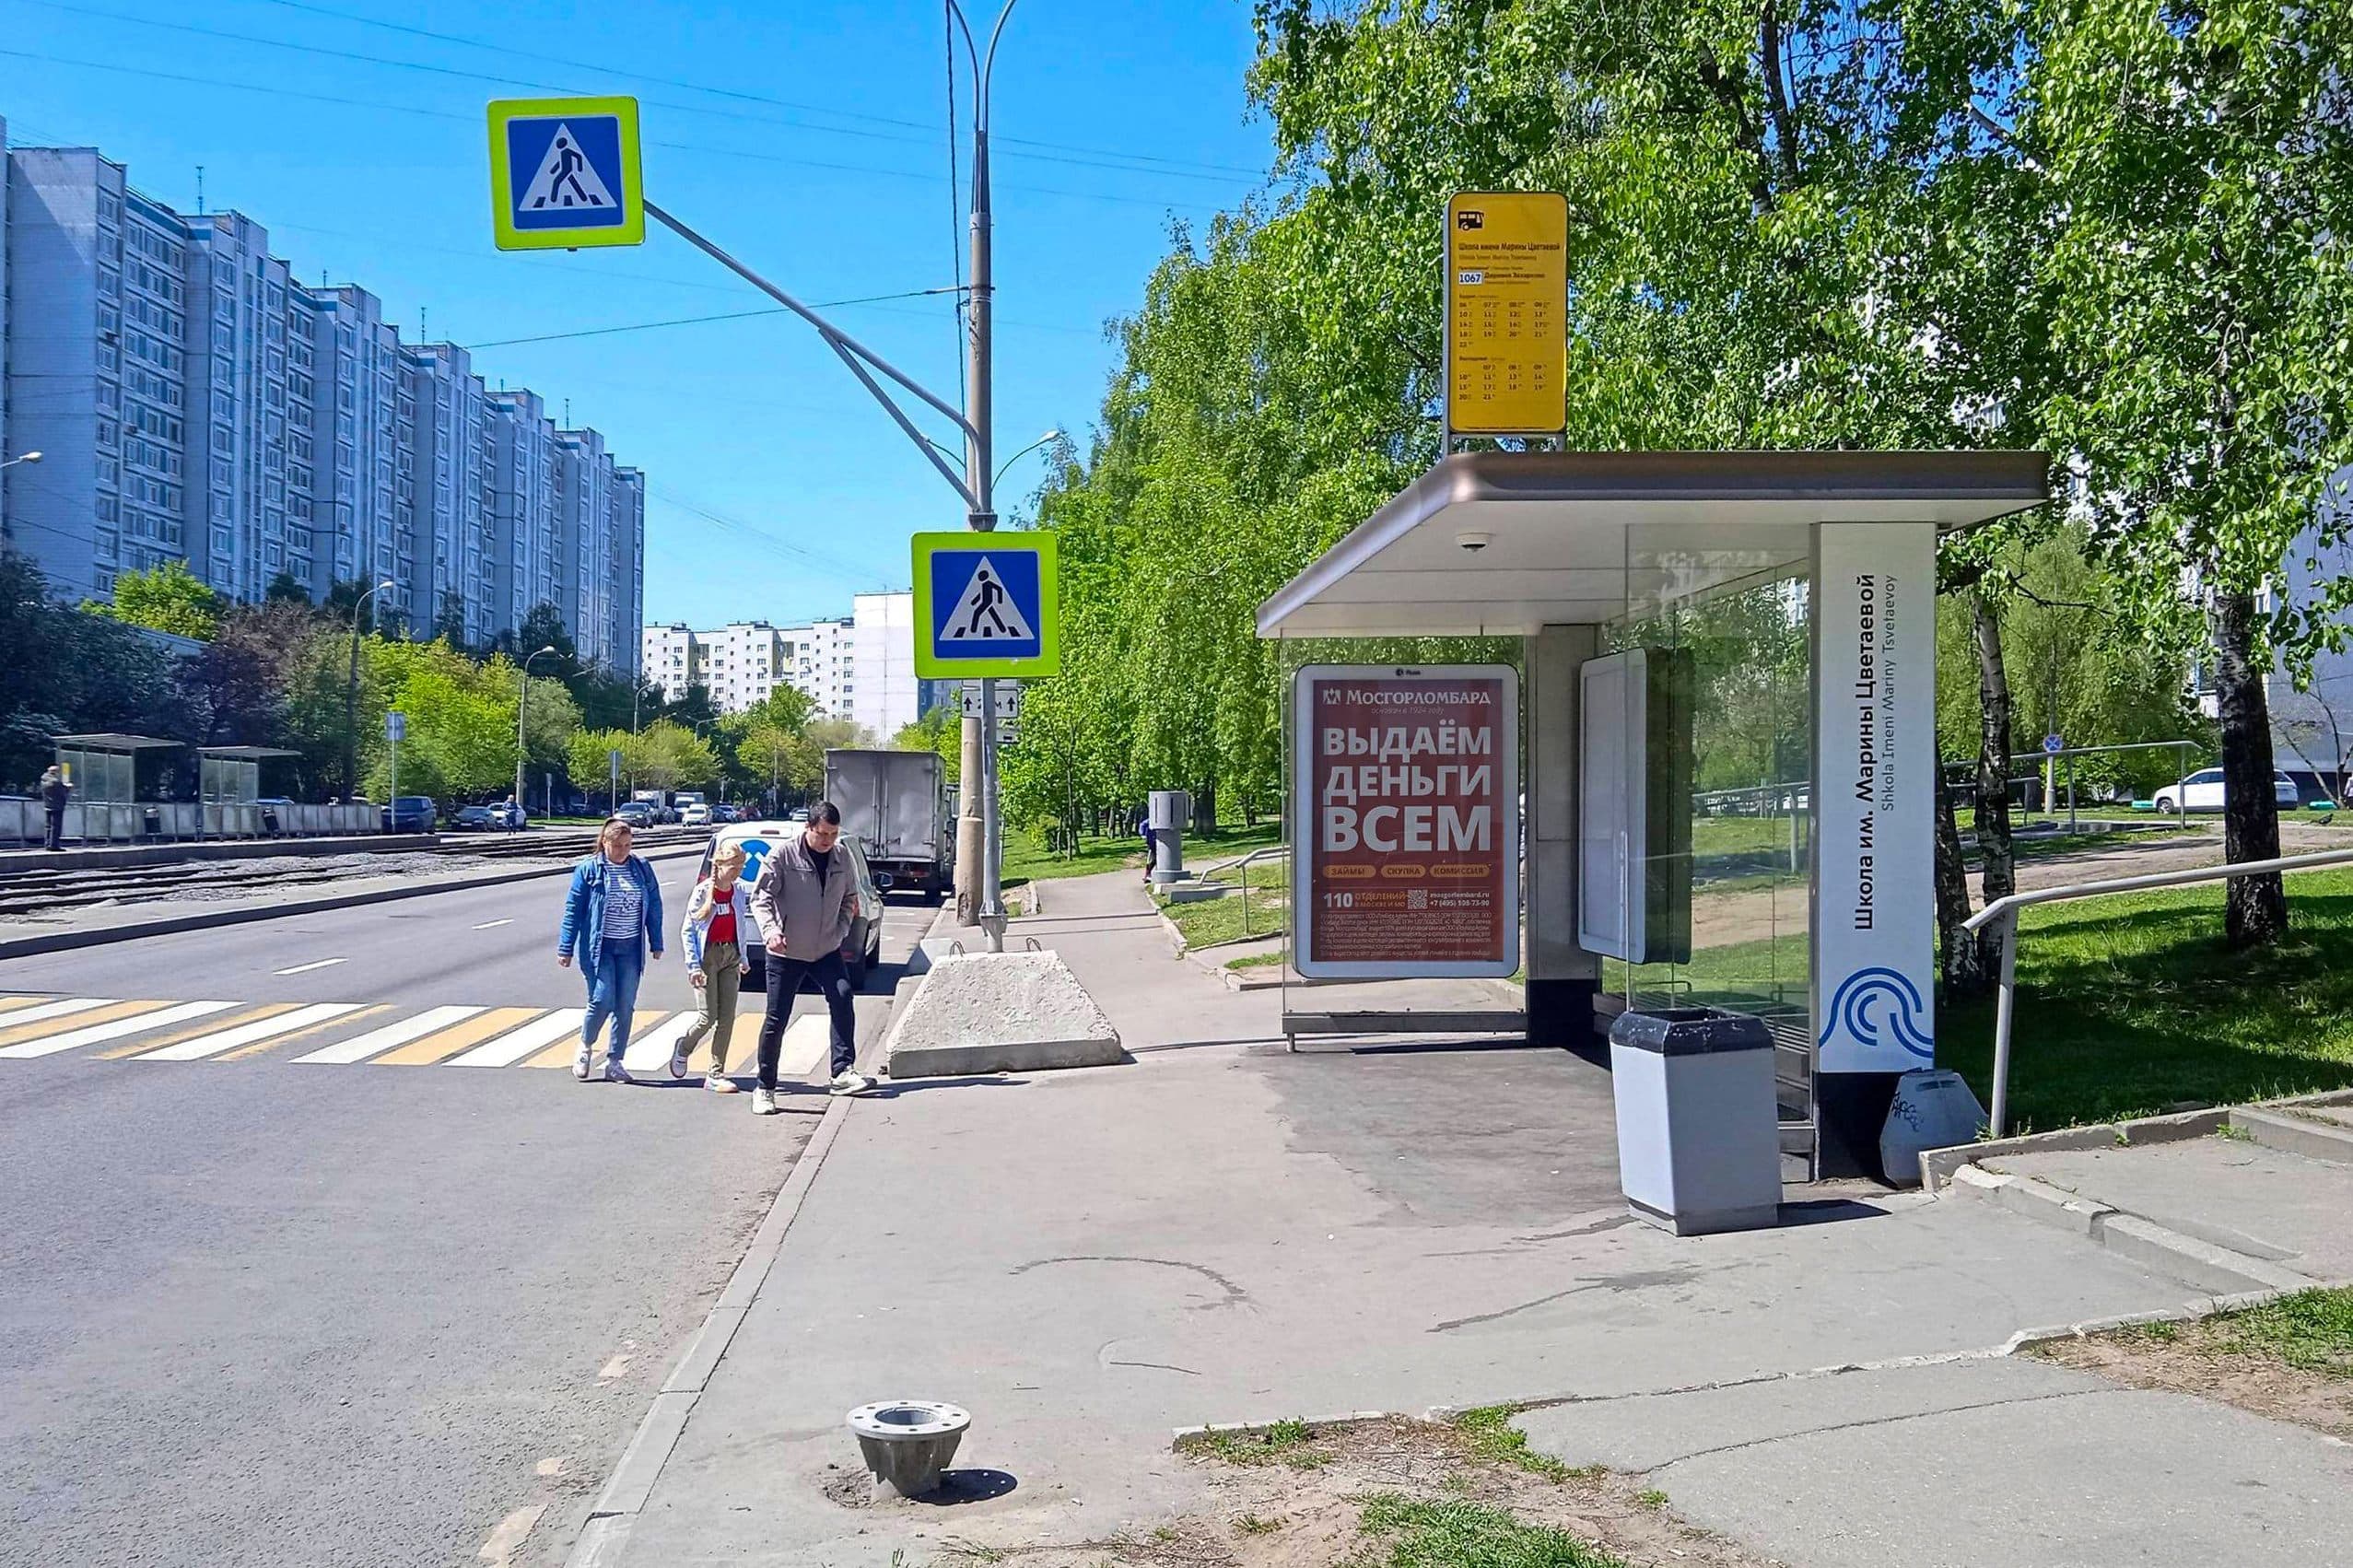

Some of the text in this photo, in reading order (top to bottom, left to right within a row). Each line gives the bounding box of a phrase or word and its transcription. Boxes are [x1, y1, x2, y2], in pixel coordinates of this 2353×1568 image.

[1459, 274, 1481, 283] 1067
[1881, 574, 1898, 811] Shkola Imeni Mariny Tsvetaevoy
[1323, 719, 1491, 763] ВЫДАЁМ
[1855, 574, 1877, 930] Школа им. Марины Цветаевой
[1322, 766, 1491, 805] ДЕНЬГИ
[1323, 806, 1491, 852] ВСЕМ
[1331, 866, 1364, 875] ЗАЙМЫ
[1434, 867, 1484, 875] КОМИССИЯ
[1323, 892, 1352, 907] 110
[1354, 892, 1407, 902] ОТДЕЛЕНИЙ
